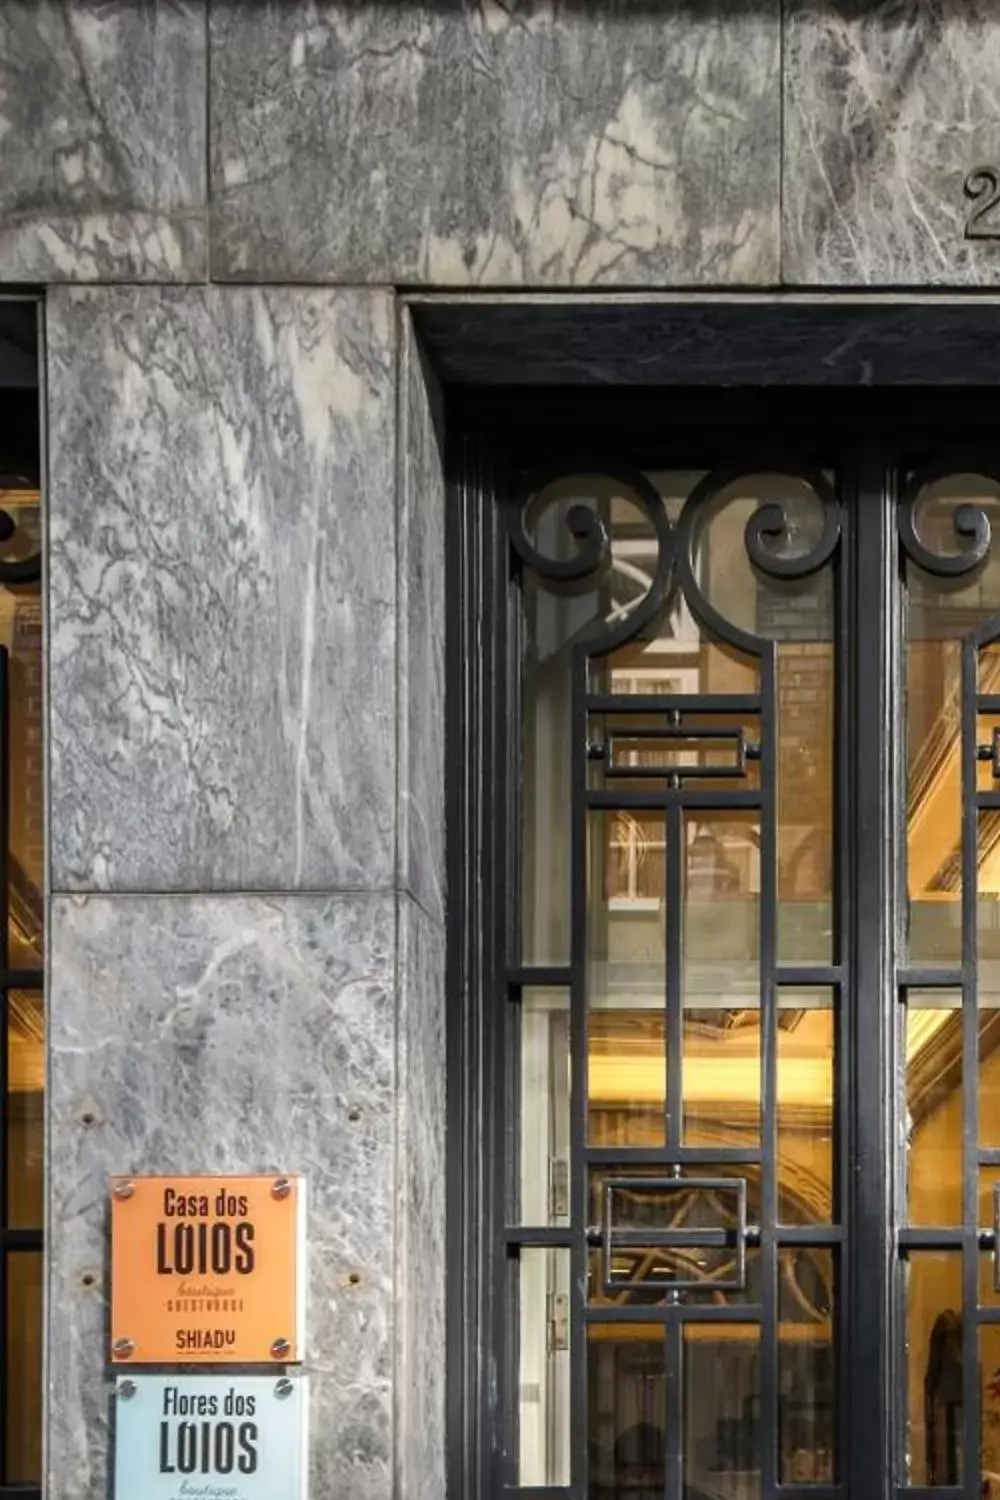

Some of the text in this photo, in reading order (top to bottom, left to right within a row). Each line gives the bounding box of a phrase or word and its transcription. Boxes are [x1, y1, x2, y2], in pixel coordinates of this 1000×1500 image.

[164, 1187, 248, 1216] Casa dos
[175, 1329, 236, 1349] SHIADU
[163, 1387, 256, 1416] Flores dos
